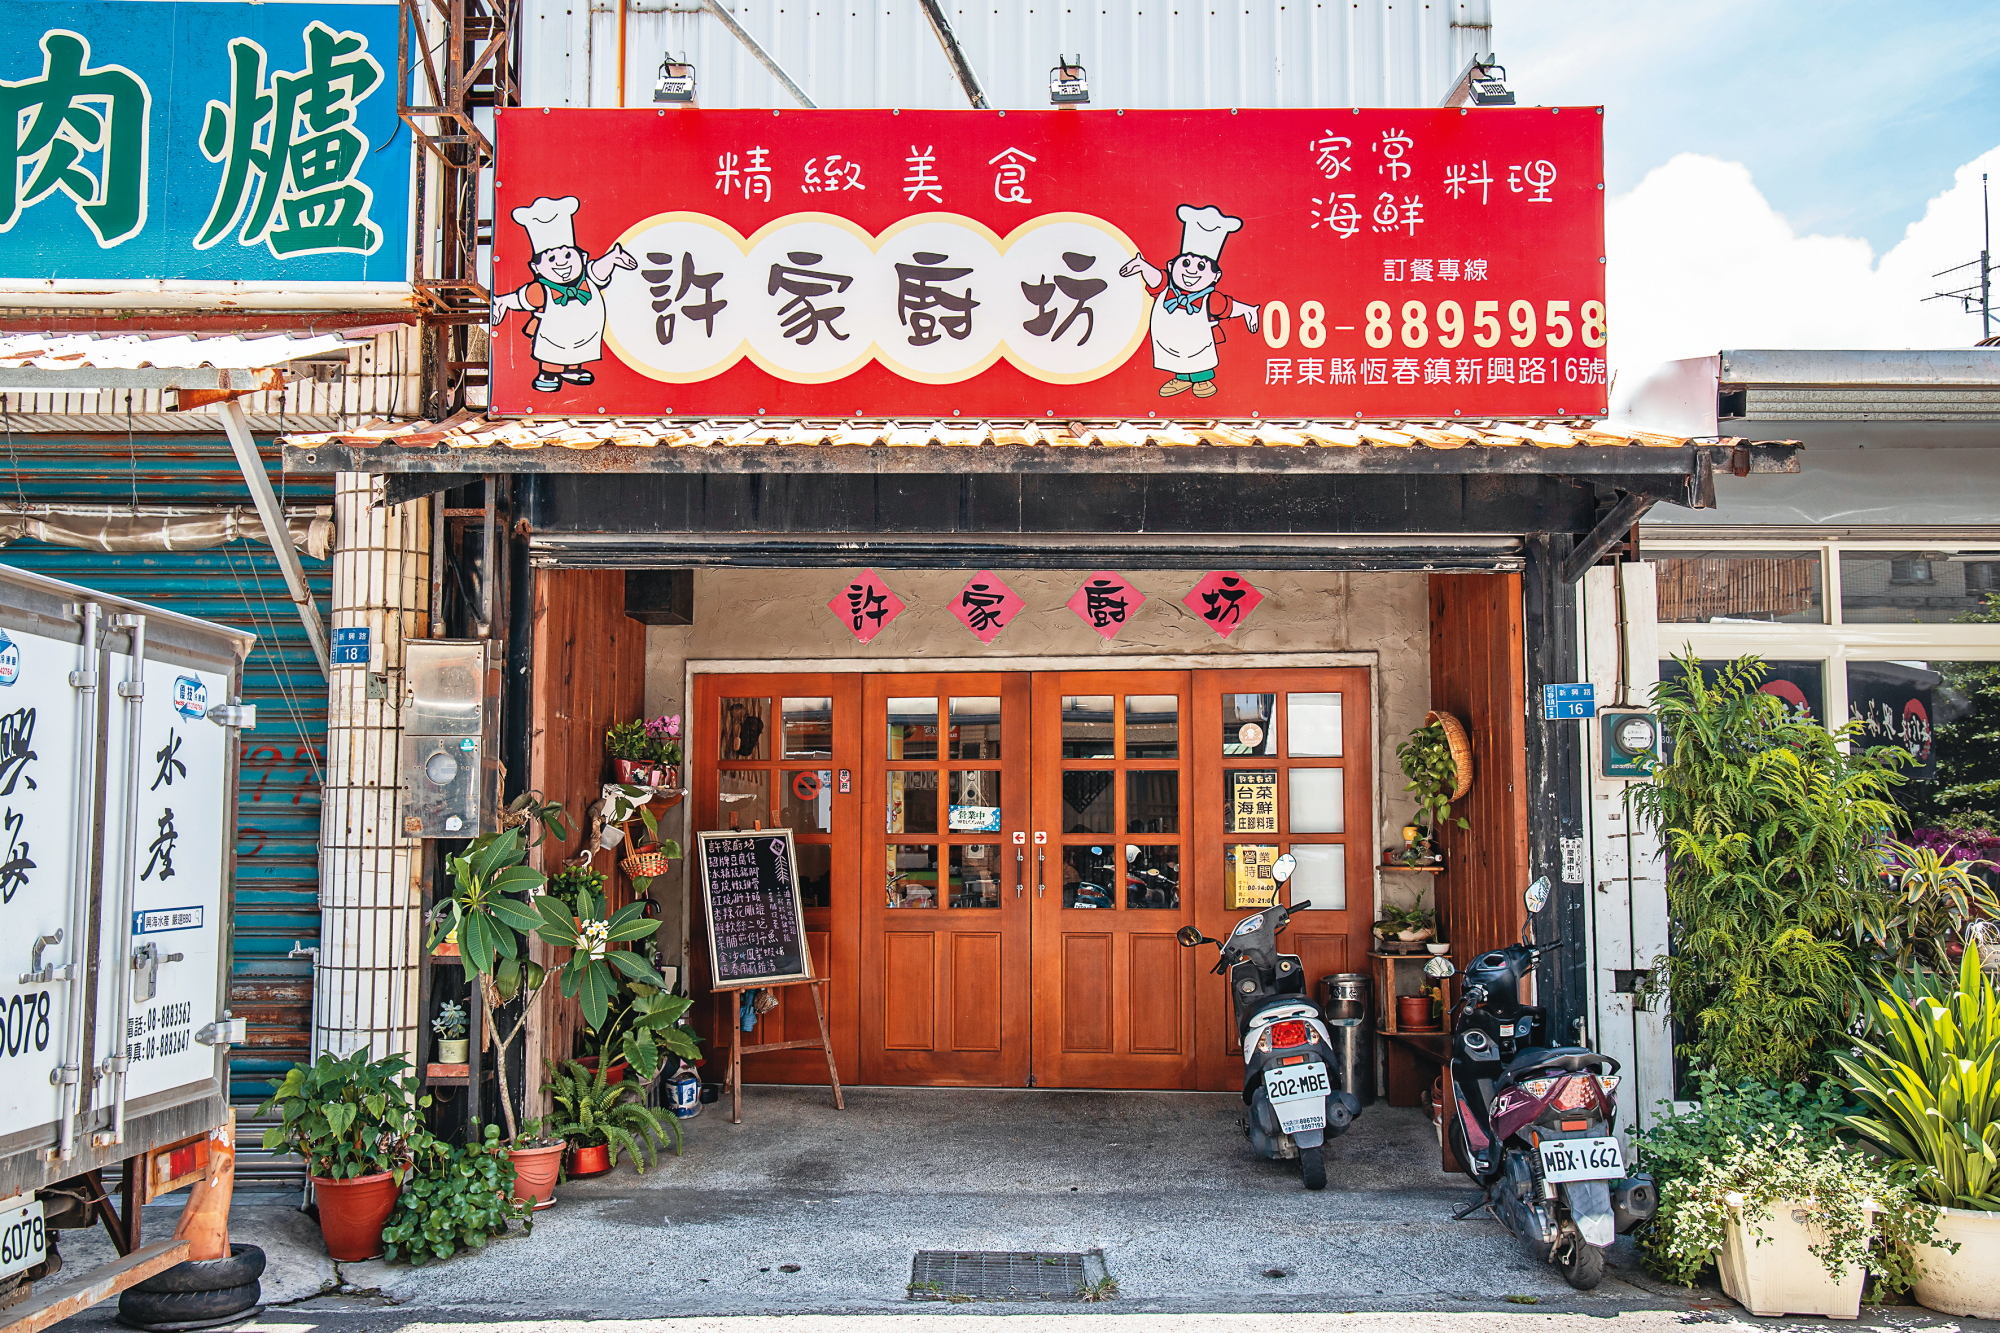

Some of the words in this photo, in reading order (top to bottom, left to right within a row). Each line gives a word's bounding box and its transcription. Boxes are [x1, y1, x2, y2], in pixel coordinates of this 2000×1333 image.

[0, 20, 384, 258] 肉爐
[1310, 127, 1414, 181] 家常
[715, 145, 1037, 204] 精緻美食
[1443, 159, 1557, 205] 料理
[1310, 191, 1425, 239] 海鮮
[1383, 257, 1489, 283] 訂餐專線
[640, 251, 1108, 347] 許家廚坊
[1262, 299, 1607, 349] 08-8895958
[1264, 357, 1606, 385] 屏東縣恆春鎮新興路16號
[851, 577, 1246, 631] 許家廚坊
[339, 632, 367, 641] 新興路
[345, 647, 358, 660] 18
[1559, 688, 1591, 696] 新興路
[1568, 702, 1584, 715] 16
[1237, 786, 1273, 800] 台菜
[957, 810, 986, 820] 營業中
[1237, 801, 1273, 815] 海鮮
[1243, 851, 1270, 864] 營業
[1244, 865, 1271, 878] 時間
[2, 1216, 44, 1264] 6078
